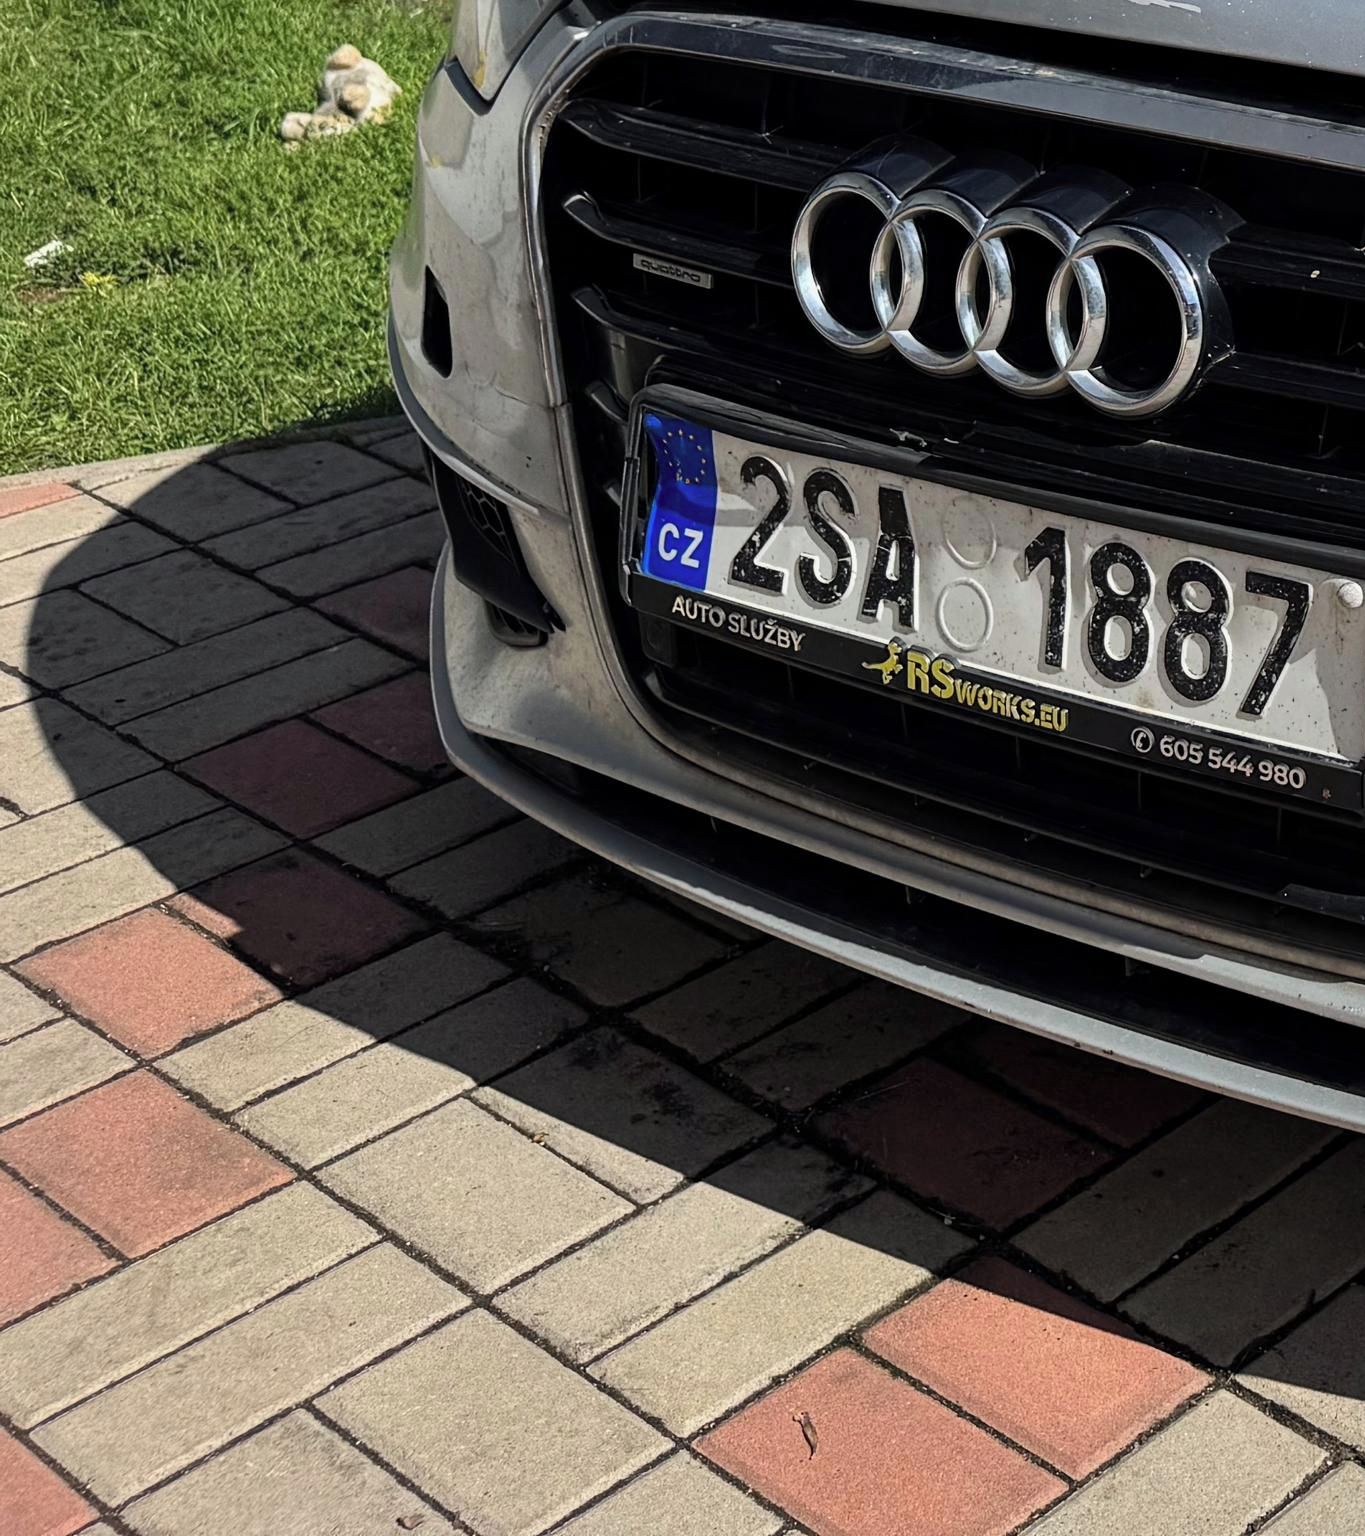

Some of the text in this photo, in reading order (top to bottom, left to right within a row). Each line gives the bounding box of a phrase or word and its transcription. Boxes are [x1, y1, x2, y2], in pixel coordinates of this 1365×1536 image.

[657, 522, 704, 569] CZ
[730, 455, 1314, 716] 2SA 1887
[671, 595, 805, 652] AUTO SLUŽBY
[1160, 734, 1307, 790] 605 544 980
